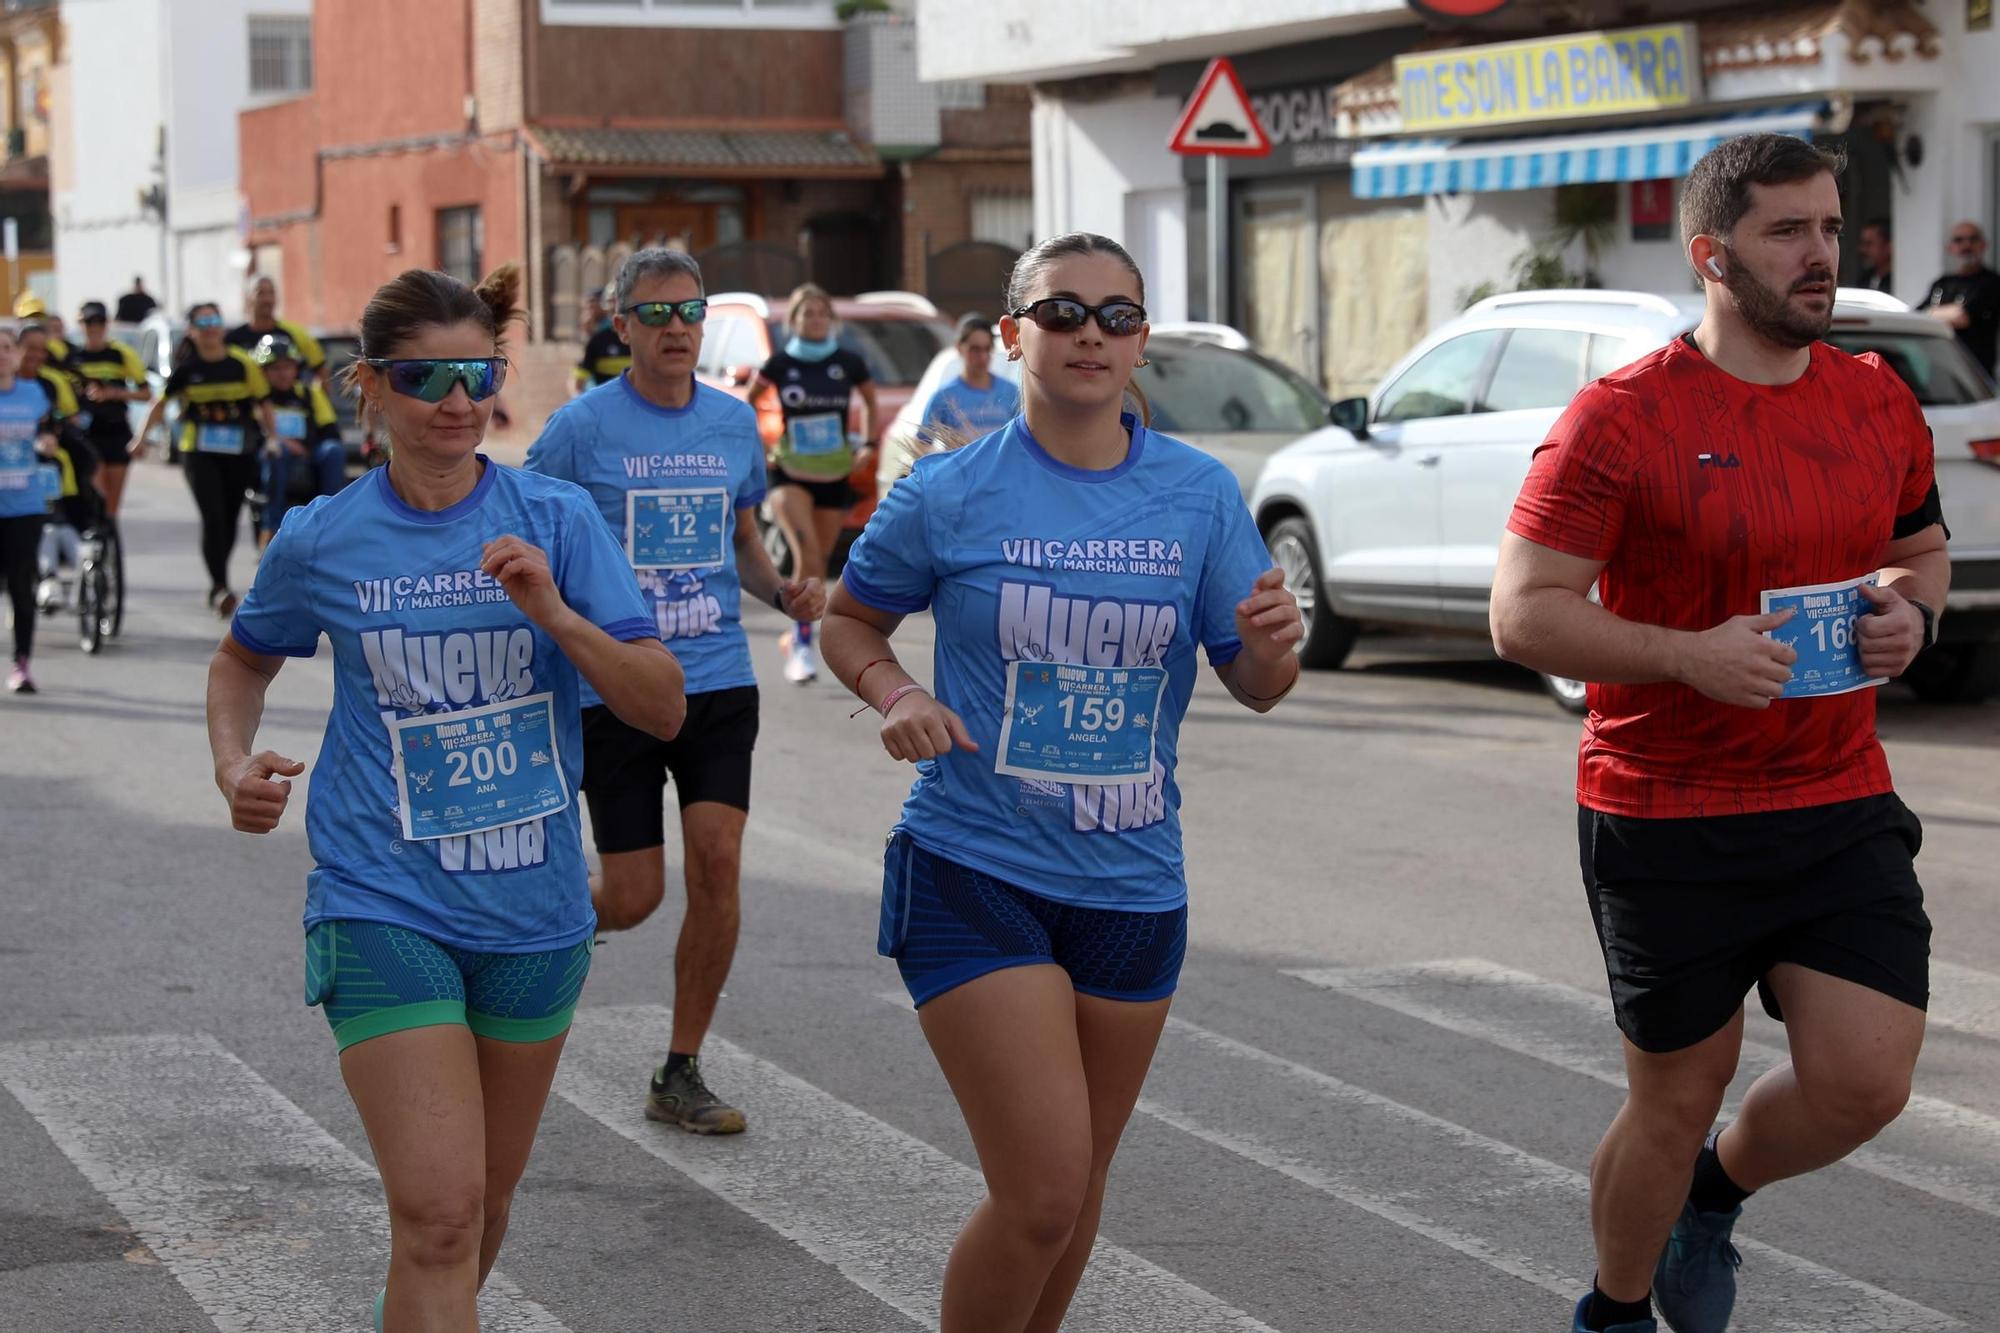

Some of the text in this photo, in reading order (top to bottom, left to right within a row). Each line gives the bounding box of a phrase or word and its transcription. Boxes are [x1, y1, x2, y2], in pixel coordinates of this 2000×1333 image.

[1403, 37, 1685, 119] MESON LA BARRA
[623, 454, 727, 479] VII CARRERA
[652, 467, 728, 478] Y MARCHA URBANA
[1698, 453, 1742, 470] FILA
[669, 513, 697, 536] 12
[1002, 539, 1183, 568] VII CARRERA
[1047, 558, 1181, 577] Y MARCHA URBANA
[354, 569, 502, 614] VII CARRE
[396, 588, 511, 611] Y MARCHA URB
[1818, 604, 1849, 615] CARRERA
[1000, 581, 1177, 668] Mueve
[360, 627, 534, 706] Mueve
[1832, 652, 1848, 662] Juan
[1058, 680, 1070, 693] VII
[1070, 681, 1111, 692] CARRERA
[1058, 694, 1126, 732] 159
[436, 722, 468, 740] Mueve
[475, 718, 486, 732] la
[492, 712, 512, 729] vida
[441, 739, 453, 750] VII
[453, 730, 496, 745] CARRERA
[1068, 733, 1109, 744] ANGELA
[445, 741, 518, 787] 200
[476, 784, 498, 795] ANA
